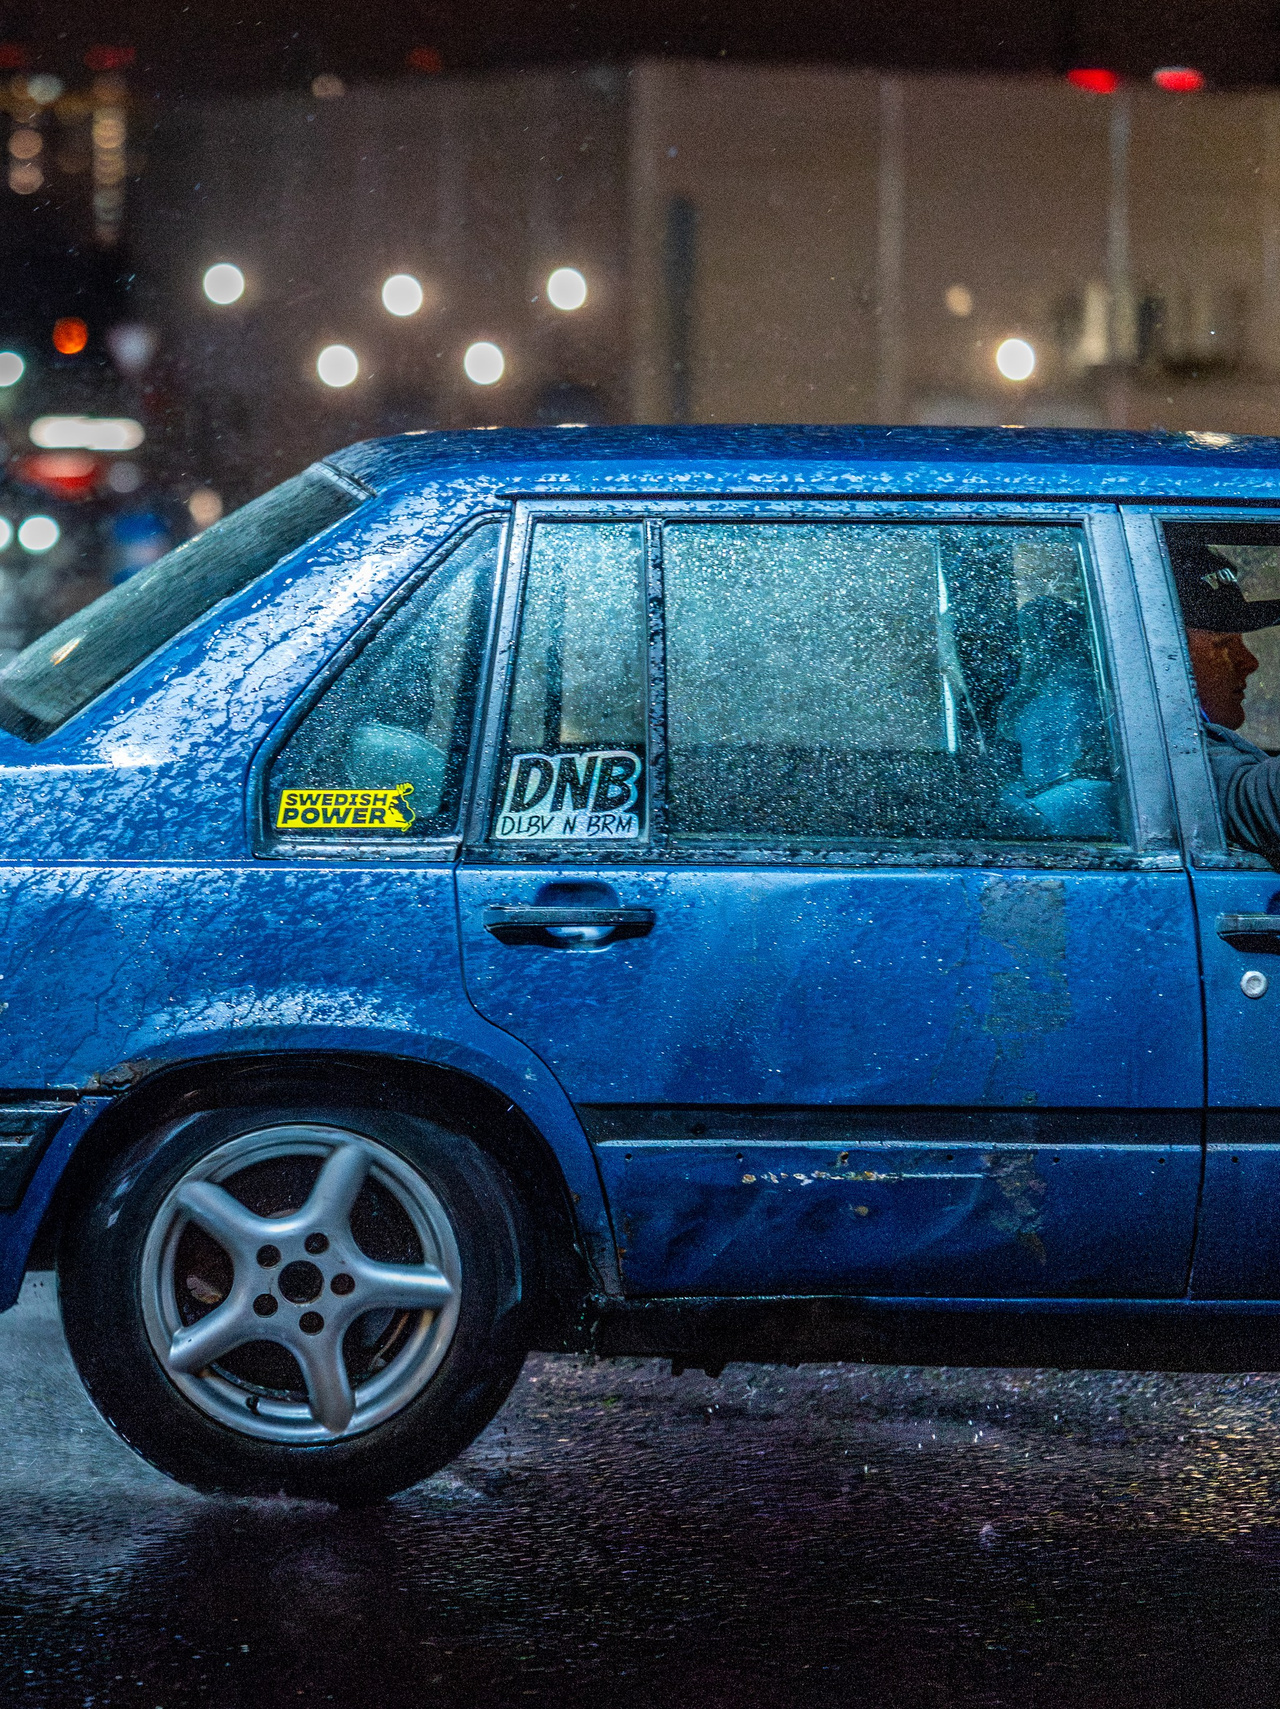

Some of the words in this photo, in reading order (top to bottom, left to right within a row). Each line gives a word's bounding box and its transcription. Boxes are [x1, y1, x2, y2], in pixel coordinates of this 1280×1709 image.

[509, 756, 635, 813] DNB
[285, 793, 388, 806] SWEDISH
[281, 808, 386, 824] POWER
[563, 815, 577, 835] N
[586, 814, 633, 836] BRM
